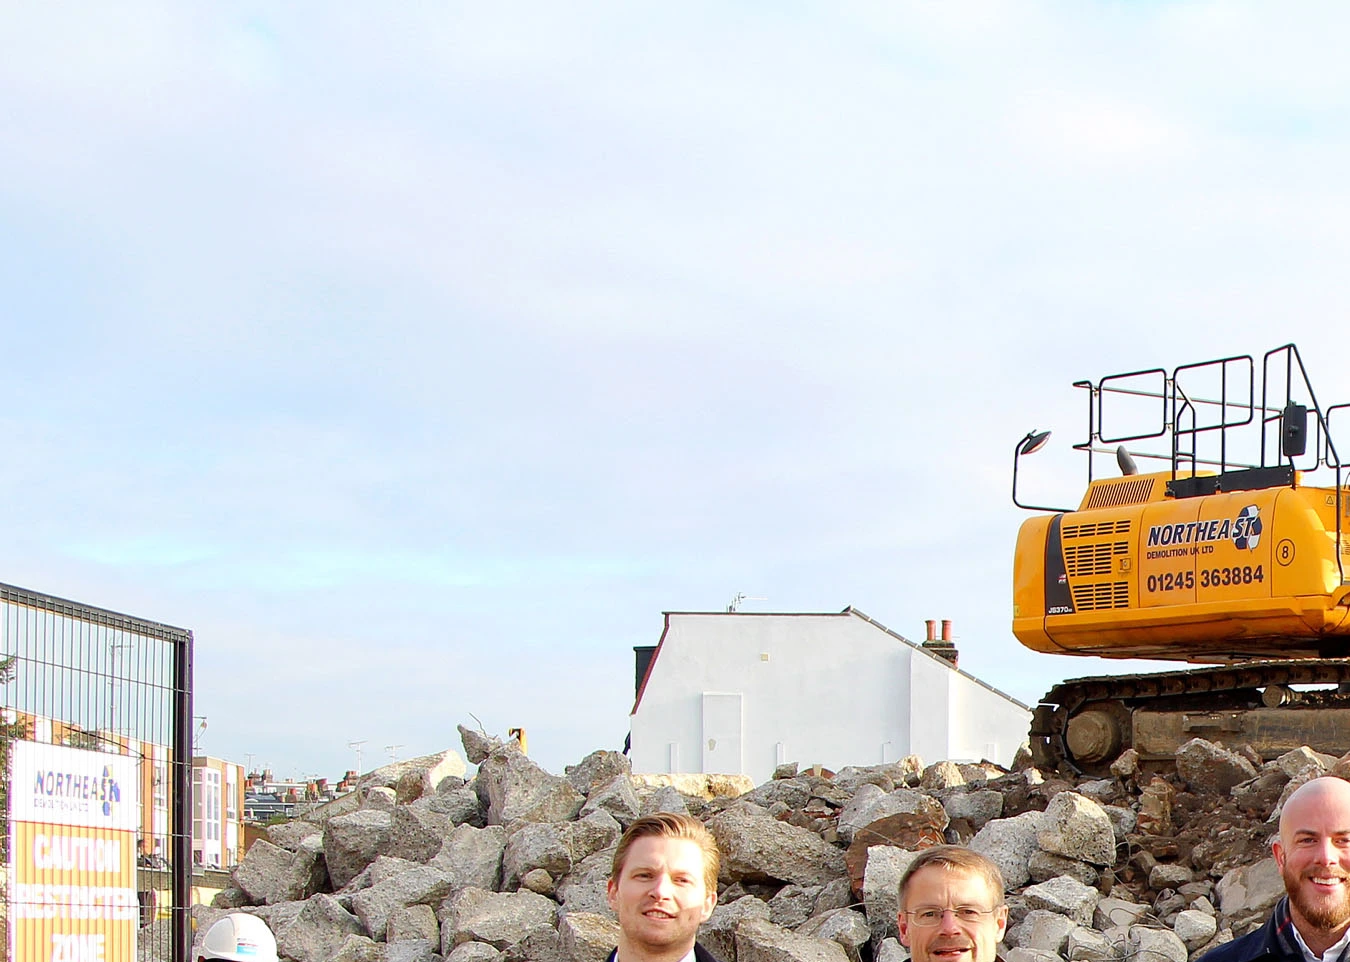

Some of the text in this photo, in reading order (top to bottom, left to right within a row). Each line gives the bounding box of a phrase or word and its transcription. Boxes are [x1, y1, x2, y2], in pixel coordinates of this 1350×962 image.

[1147, 515, 1258, 548] NORTHEAST
[1146, 545, 1214, 560] DEMOLITION UK LTD
[1281, 545, 1289, 559] 8
[1147, 565, 1264, 593] 01245 363884
[34, 768, 114, 802] NORTHEAST
[33, 833, 121, 873] CAUTION
[16, 882, 136, 920] RESTRICTED
